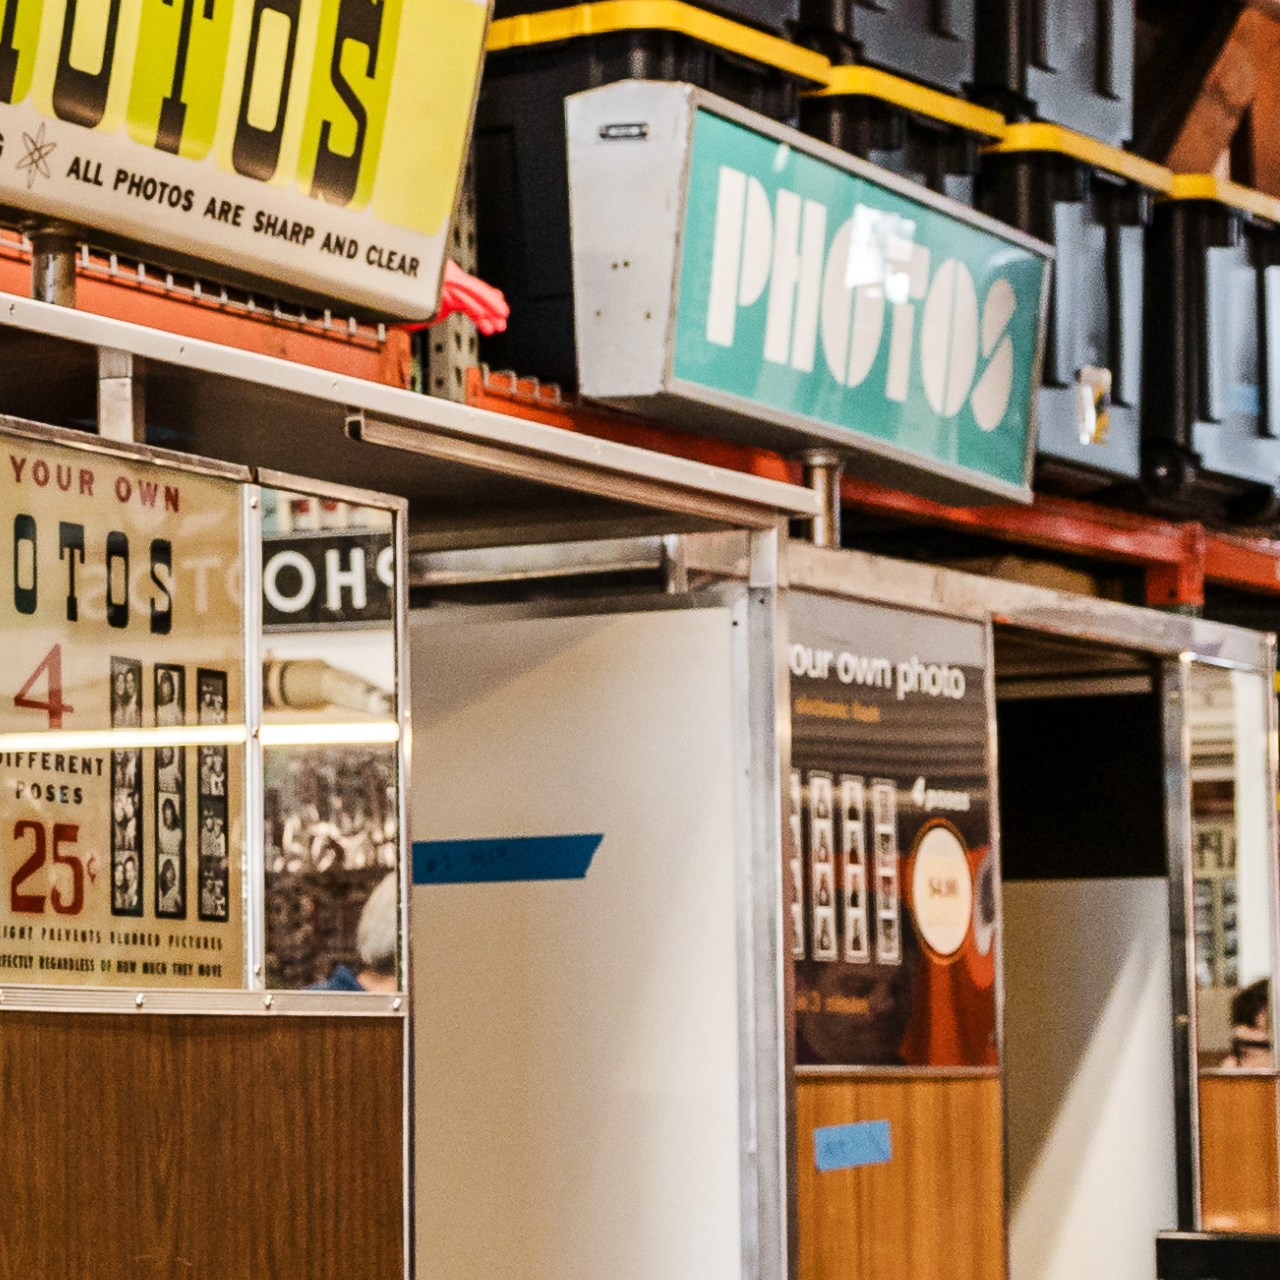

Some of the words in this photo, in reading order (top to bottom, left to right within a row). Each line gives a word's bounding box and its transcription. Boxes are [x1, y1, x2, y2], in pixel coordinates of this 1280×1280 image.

[66, 156, 103, 187] ALL
[113, 169, 194, 212] PHOTOS
[203, 197, 245, 227] ARE
[252, 211, 315, 247] SHARP
[321, 233, 358, 260] AND
[366, 245, 420, 277] CLEAR
[706, 165, 1017, 431] PHOTOS
[10, 454, 94, 496] YOUR
[115, 477, 180, 513] OWN
[14, 643, 74, 729] 4
[838, 650, 891, 689] own
[897, 655, 965, 700] photo
[15, 780, 83, 805] POSES
[911, 776, 926, 809] 4
[39, 956, 94, 971] REGARDLESS
